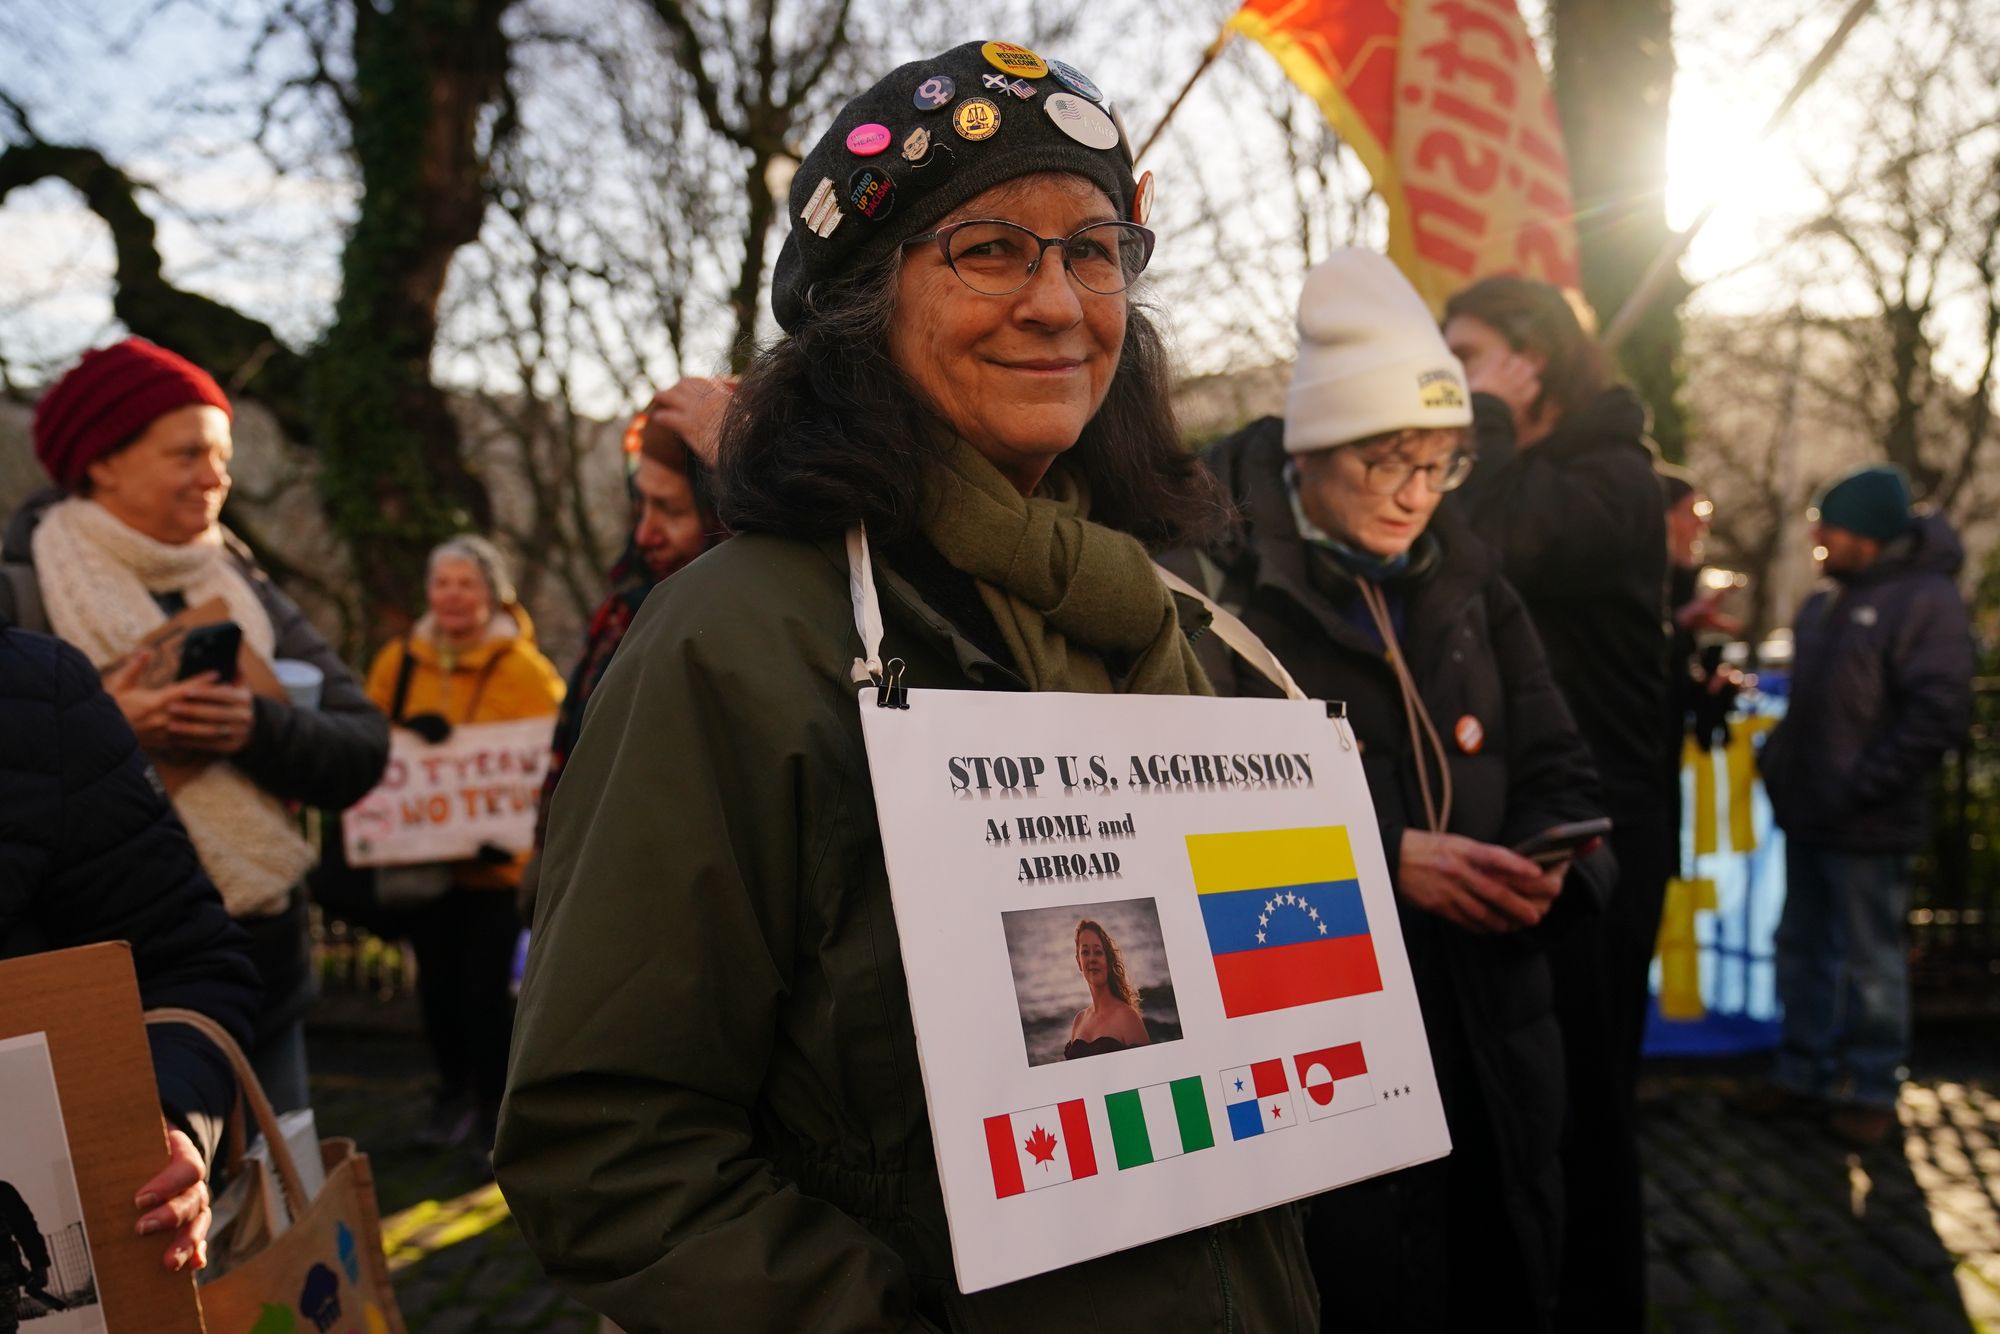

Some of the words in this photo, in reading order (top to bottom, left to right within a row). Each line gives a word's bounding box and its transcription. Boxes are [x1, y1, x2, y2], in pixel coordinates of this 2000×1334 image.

[996, 53, 1036, 61] REFUGEES
[1001, 59, 1041, 67] WELCOME
[853, 133, 885, 147] HEARD
[851, 173, 873, 204] STAND
[857, 196, 868, 211] UP
[866, 181, 879, 196] TO
[864, 179, 892, 217] RACISM
[948, 756, 1045, 789] STOP
[1054, 755, 1118, 787] U.S.
[1128, 753, 1314, 785] AGGRESSION
[986, 818, 1011, 841] At
[1016, 814, 1091, 839] HOME
[1098, 813, 1136, 835] and
[1018, 852, 1121, 880] ABROAD
